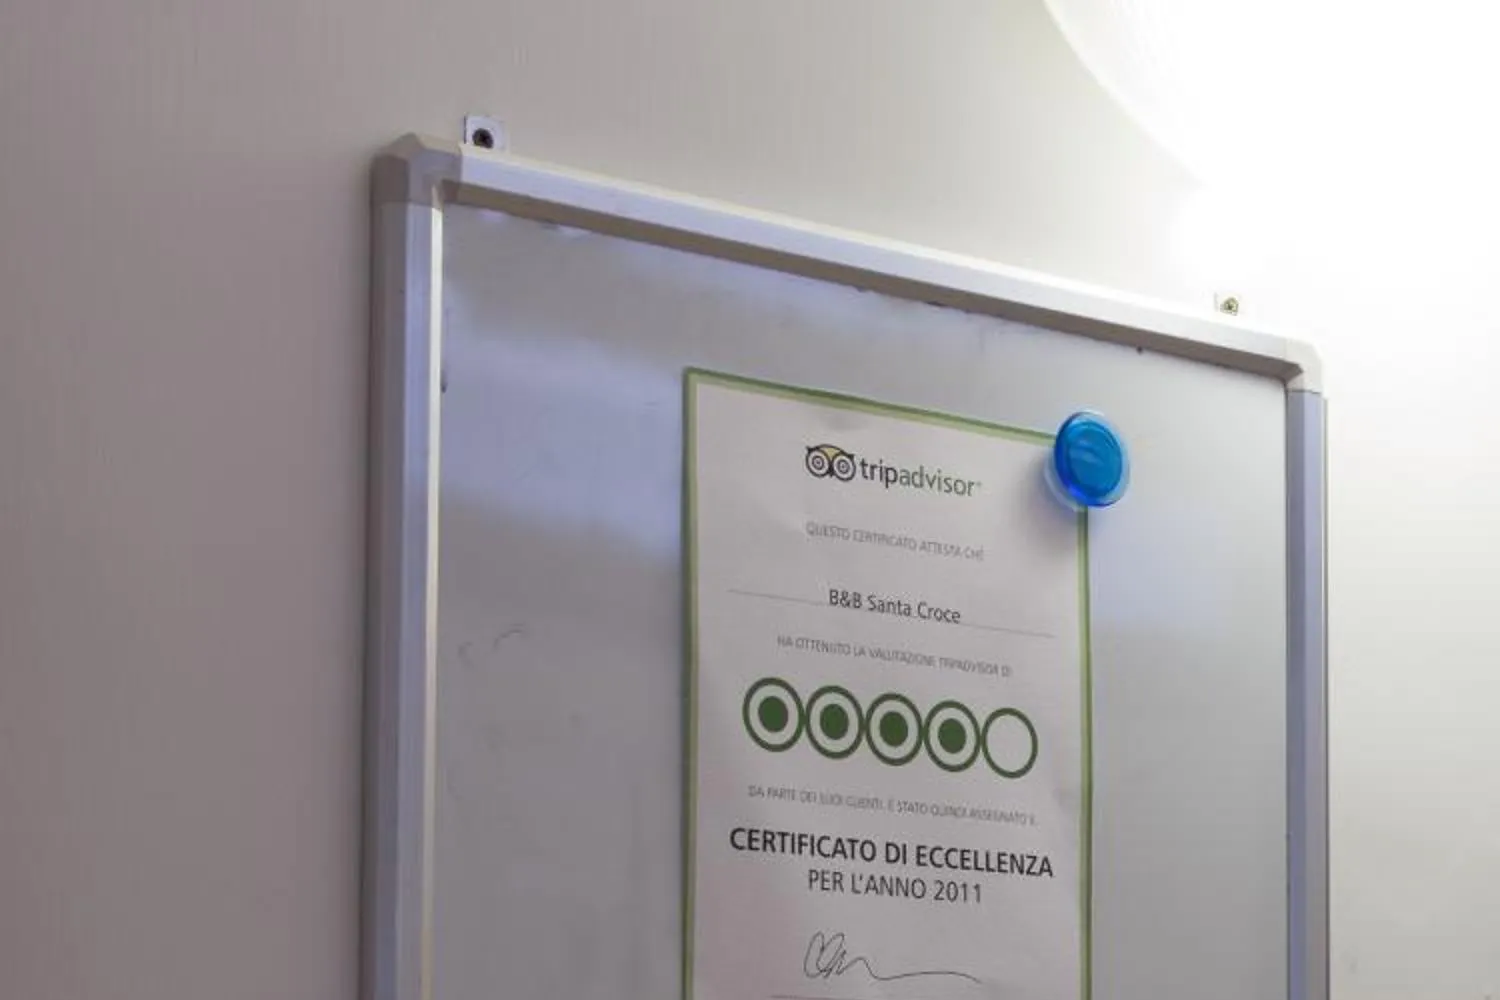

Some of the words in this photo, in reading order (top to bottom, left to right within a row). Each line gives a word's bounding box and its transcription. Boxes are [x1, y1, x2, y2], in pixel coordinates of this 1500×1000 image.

[859, 457, 975, 497] tripadvisor
[805, 521, 850, 541] QUESTO
[852, 529, 918, 550] CERTIFICATO
[919, 539, 962, 558] ATTESTA
[828, 588, 862, 609] B&B
[867, 594, 911, 617] Santa
[917, 601, 961, 624] Croce
[777, 635, 793, 648] HA
[795, 636, 851, 655] OTTENUTO
[853, 646, 866, 658] LA
[868, 648, 935, 668] VALUTAZIONE
[747, 785, 765, 798] DA
[767, 786, 796, 801] PARTE
[897, 799, 928, 815] STATO
[729, 827, 877, 863] CERTIFICATO
[885, 842, 907, 865] DI
[916, 845, 1054, 878] ECCELLENZA
[808, 868, 845, 893] PER
[851, 873, 927, 900] L'ANNO
[933, 878, 982, 903] 2011
